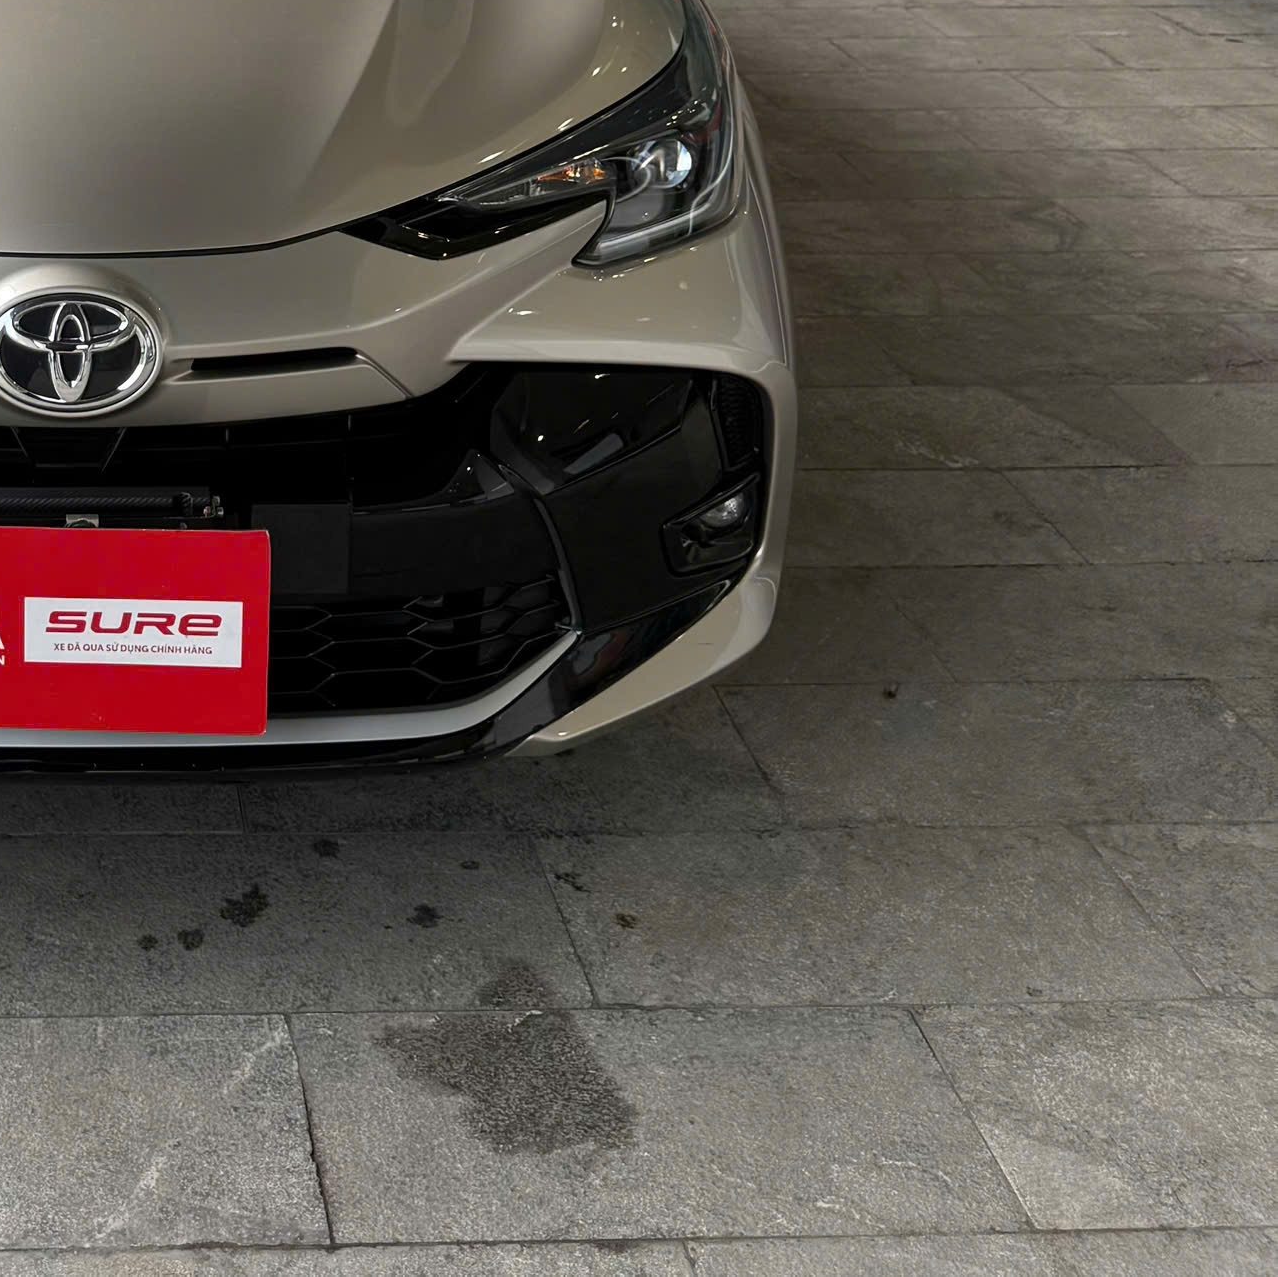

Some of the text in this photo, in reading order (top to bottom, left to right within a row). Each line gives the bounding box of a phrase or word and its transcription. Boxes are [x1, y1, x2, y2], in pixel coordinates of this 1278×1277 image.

[54, 643, 65, 651] XE
[67, 641, 81, 651] ĐÃ
[83, 643, 103, 652] QUA
[106, 641, 119, 652] SỬ
[121, 644, 149, 654] DỤNG
[151, 643, 182, 654] CHÍNH
